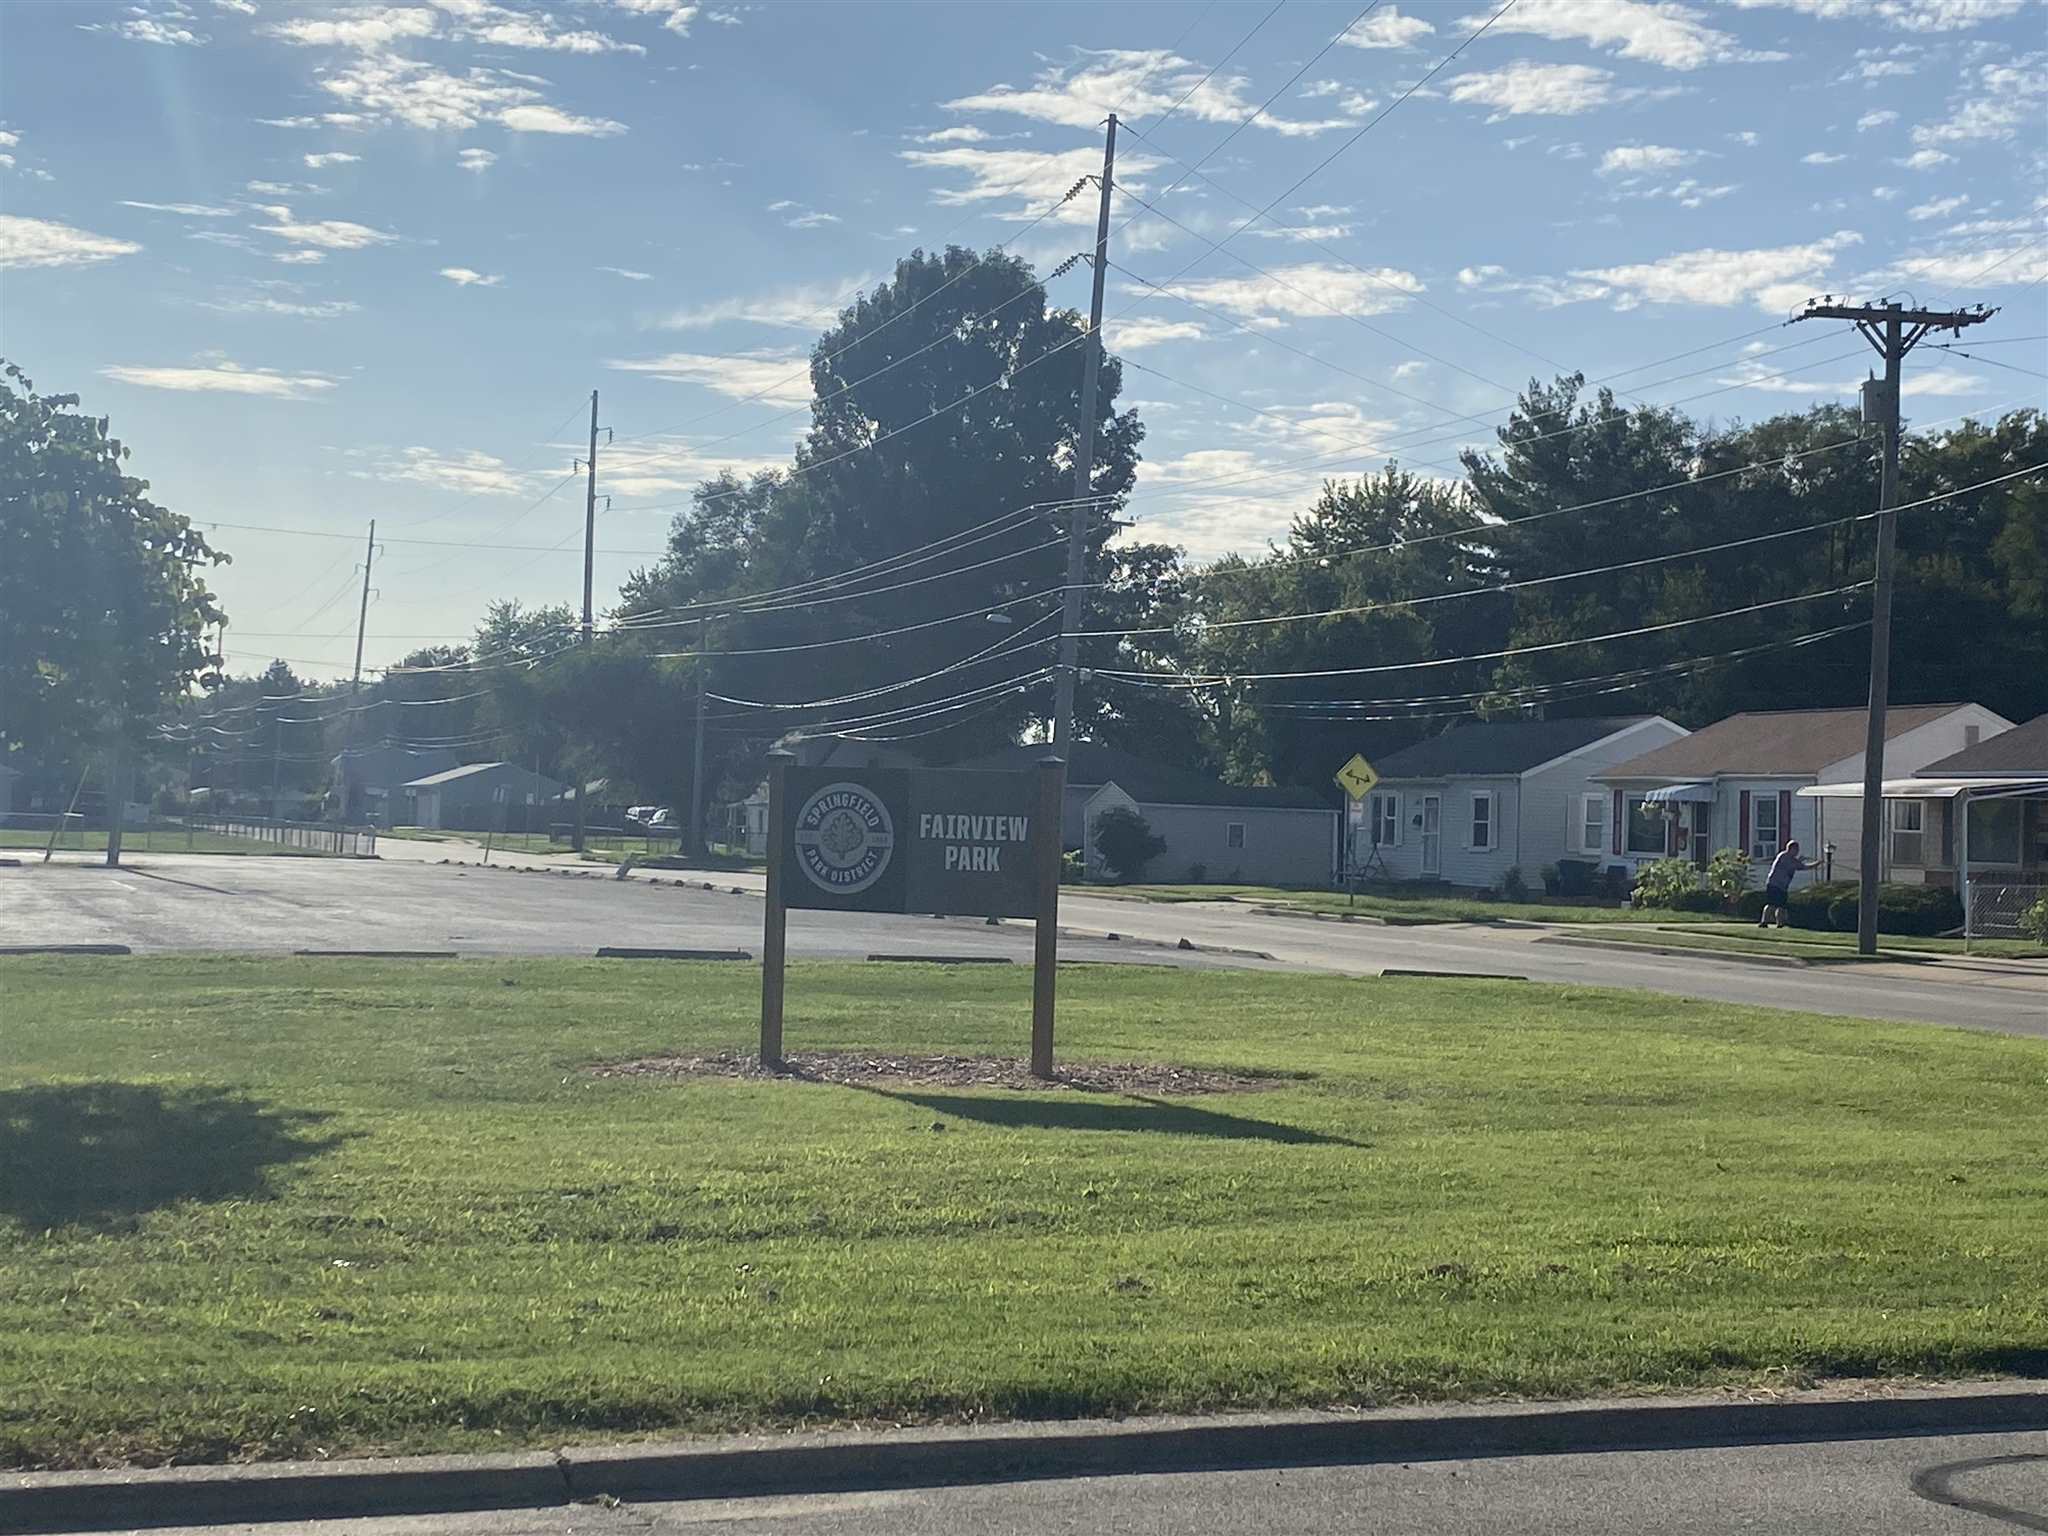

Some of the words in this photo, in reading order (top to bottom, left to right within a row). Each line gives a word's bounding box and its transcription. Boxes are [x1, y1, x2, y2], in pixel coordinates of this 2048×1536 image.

[807, 793, 880, 827] SPRINGFIELD
[920, 814, 1028, 841] FAIRVIEW
[807, 849, 829, 875] PARK
[830, 850, 878, 882] DISTRICT
[945, 846, 1001, 872] PARK
